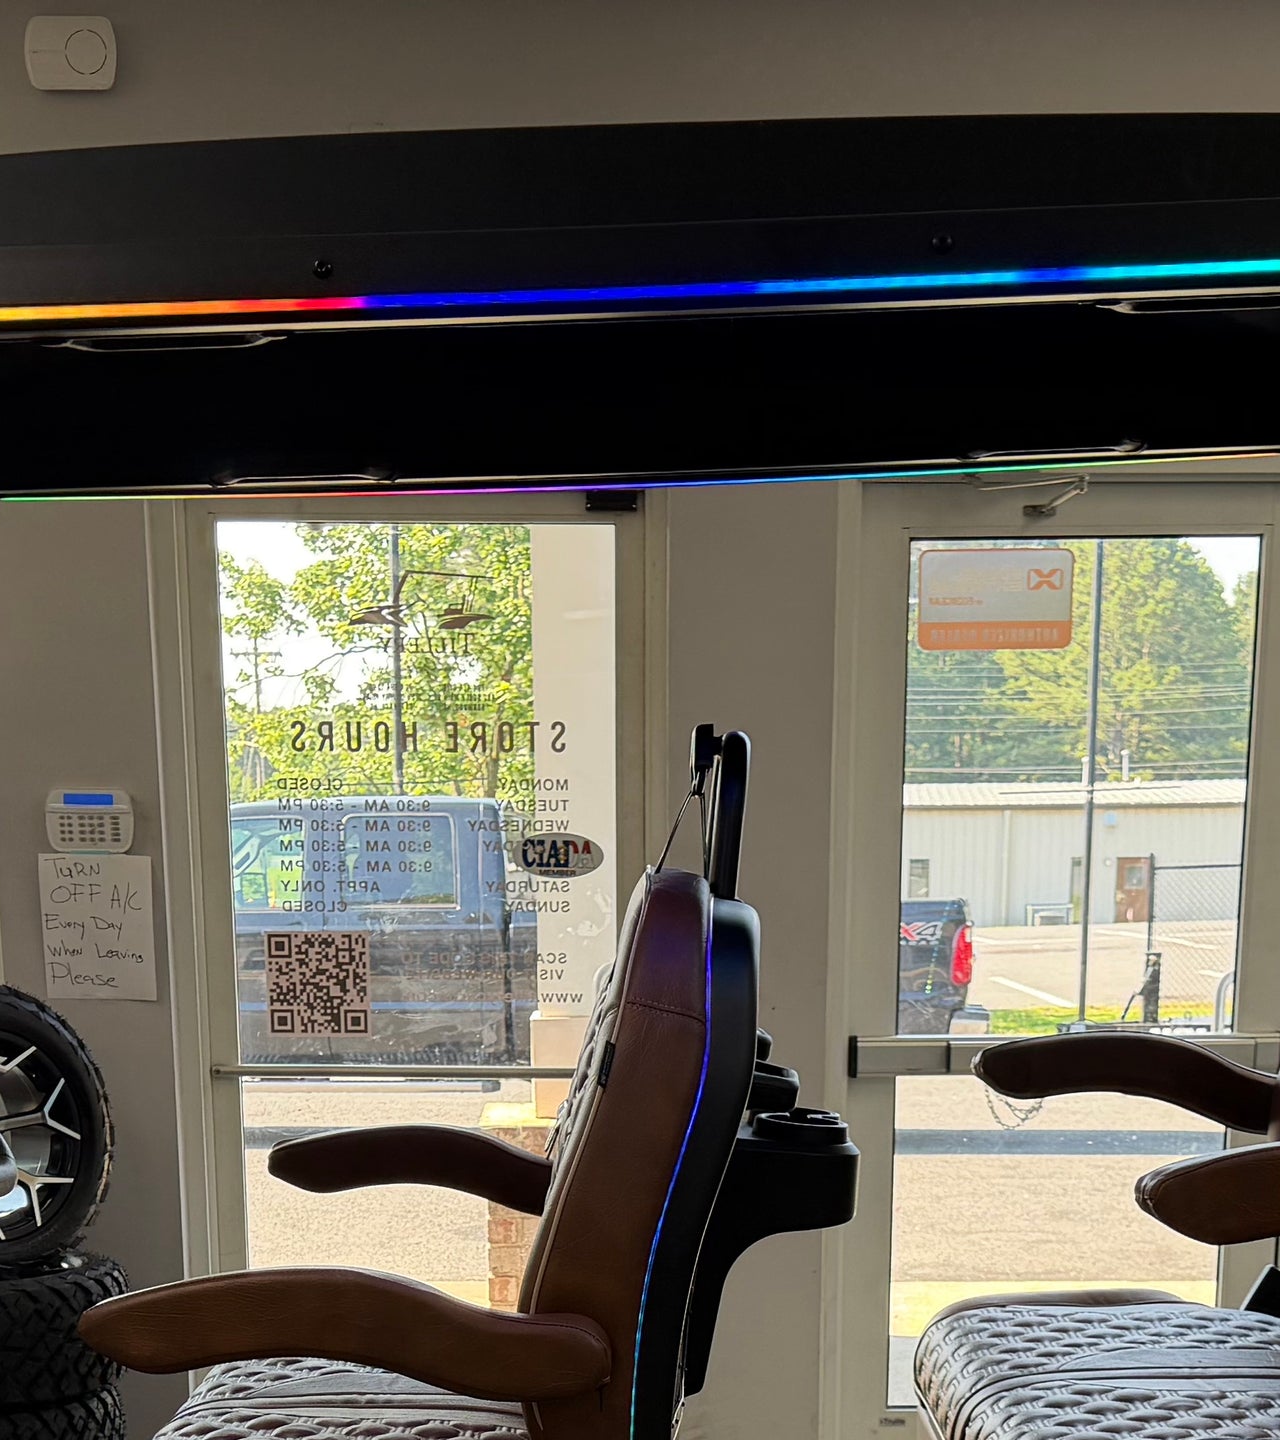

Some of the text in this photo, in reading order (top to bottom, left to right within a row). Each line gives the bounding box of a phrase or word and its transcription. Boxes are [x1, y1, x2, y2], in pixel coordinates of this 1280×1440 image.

[522, 838, 596, 868] CIADA
[50, 882, 142, 914] OFF A/C
[44, 914, 122, 940] Every Day
[94, 943, 144, 964] Leaving
[48, 962, 119, 988] Please
